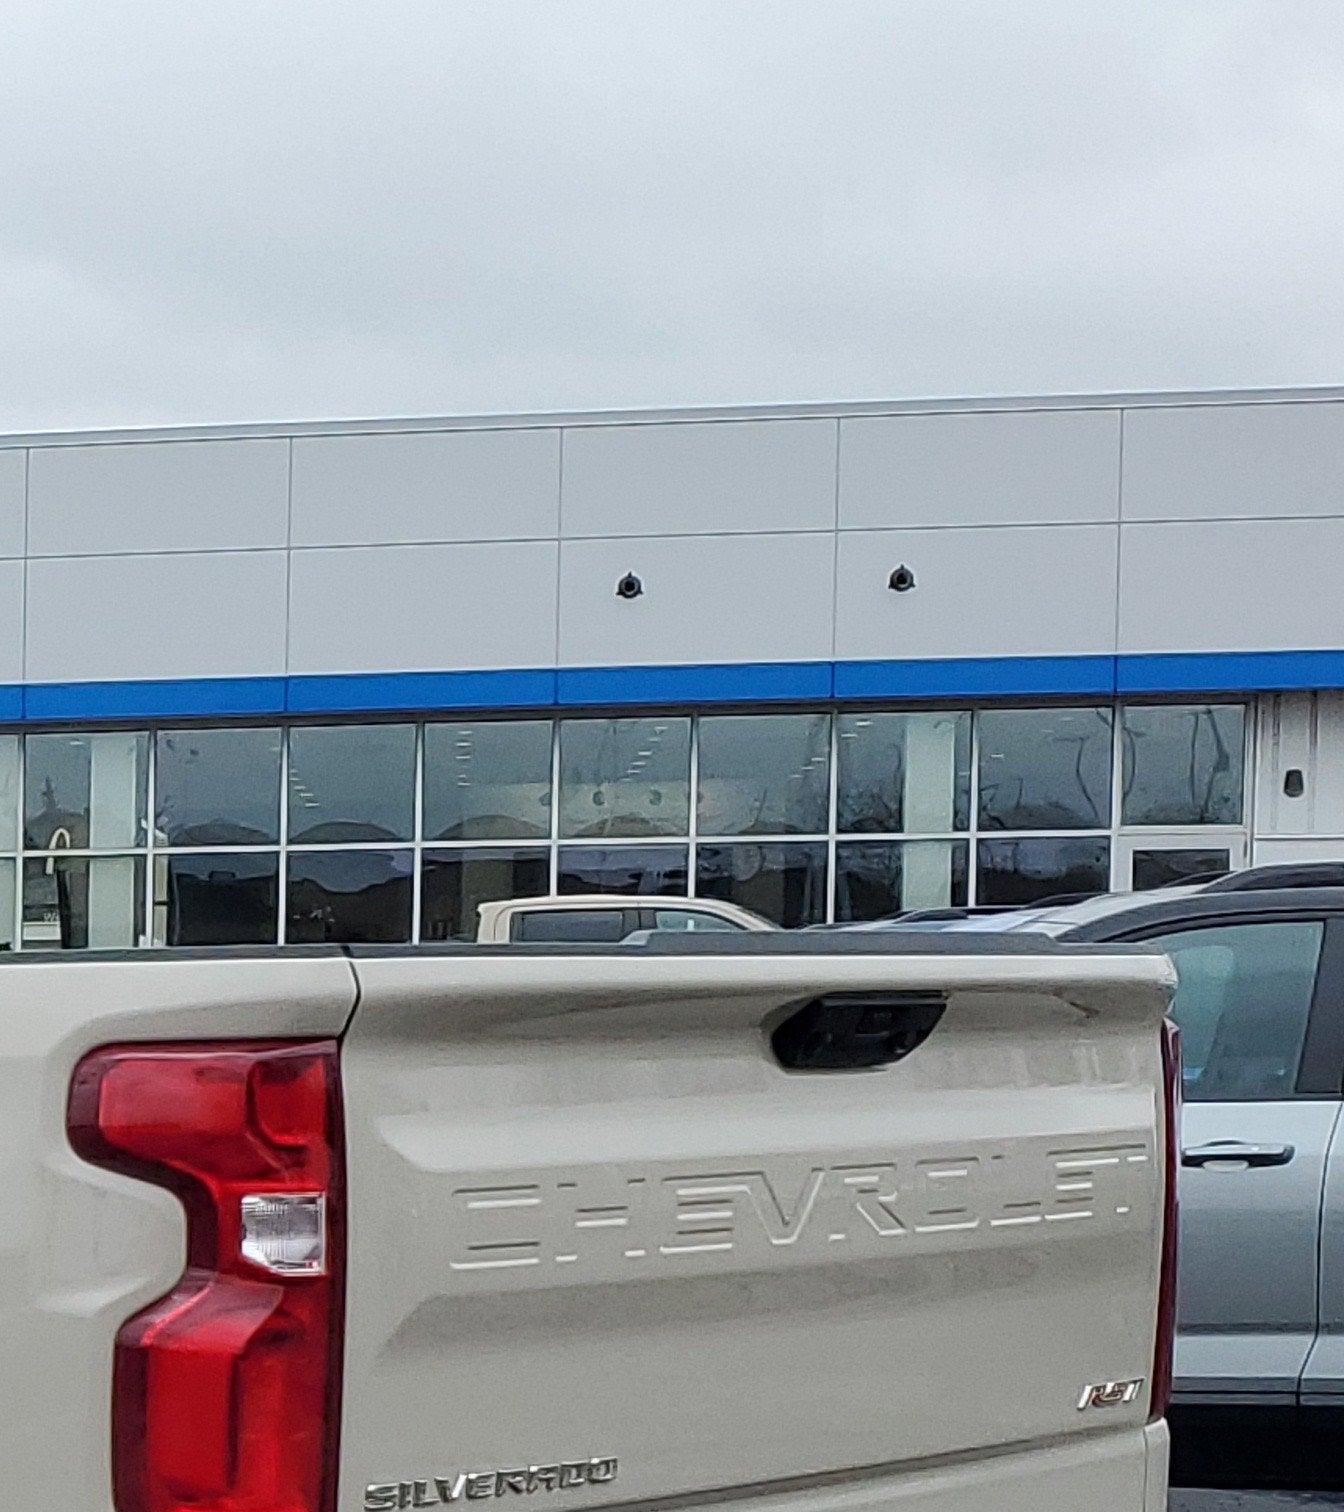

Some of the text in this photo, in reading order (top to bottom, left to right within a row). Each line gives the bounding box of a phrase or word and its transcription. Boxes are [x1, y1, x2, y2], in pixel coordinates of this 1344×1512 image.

[450, 1143, 1148, 1269] CHEVROLET
[1077, 1378, 1145, 1411] RST
[364, 1456, 618, 1512] SILVERADO
